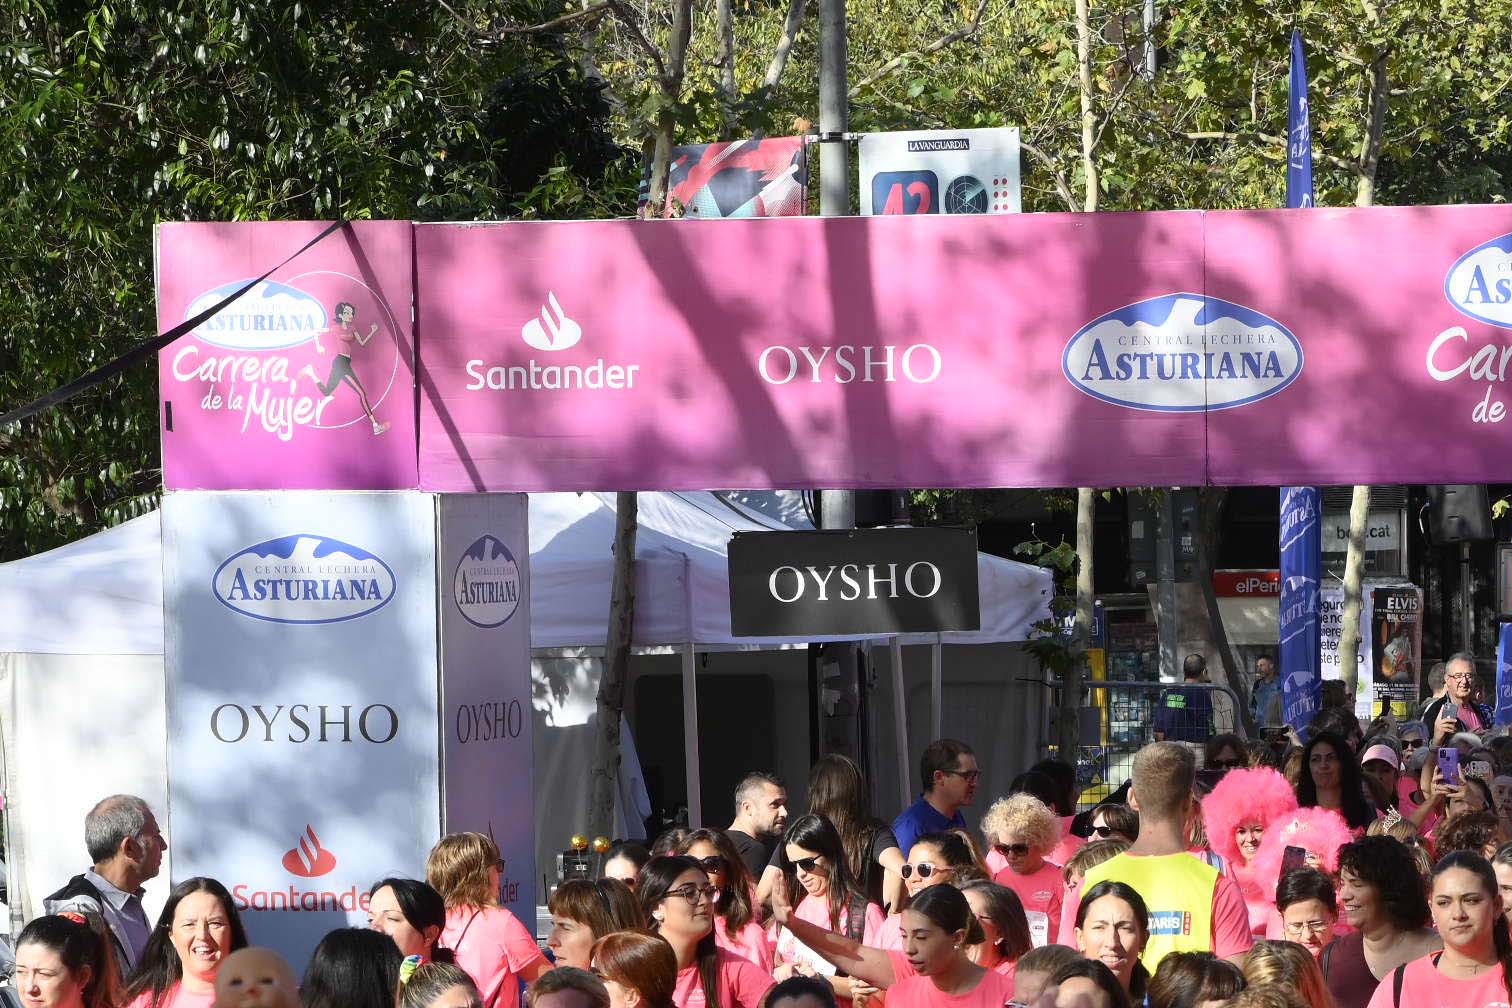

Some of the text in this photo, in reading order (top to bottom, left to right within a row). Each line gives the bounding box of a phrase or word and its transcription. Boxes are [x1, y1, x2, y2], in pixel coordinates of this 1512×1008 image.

[1081, 337, 1283, 381] ASTURIANA
[1118, 335, 1193, 346] CENTRAL
[172, 345, 290, 383] Carrera
[466, 357, 639, 390] Santander
[758, 343, 942, 385] OYSHO
[201, 380, 335, 441] de la Mujer
[1472, 386, 1506, 424] de
[227, 567, 383, 602] ASTURIANA
[254, 564, 377, 575] CENTRAL LECHERA
[459, 570, 517, 606] ASTURIANA
[769, 561, 941, 602] OYSHO
[1387, 597, 1418, 610] ELVIS
[210, 703, 399, 744] OYSHO
[456, 700, 522, 744] OYSHO
